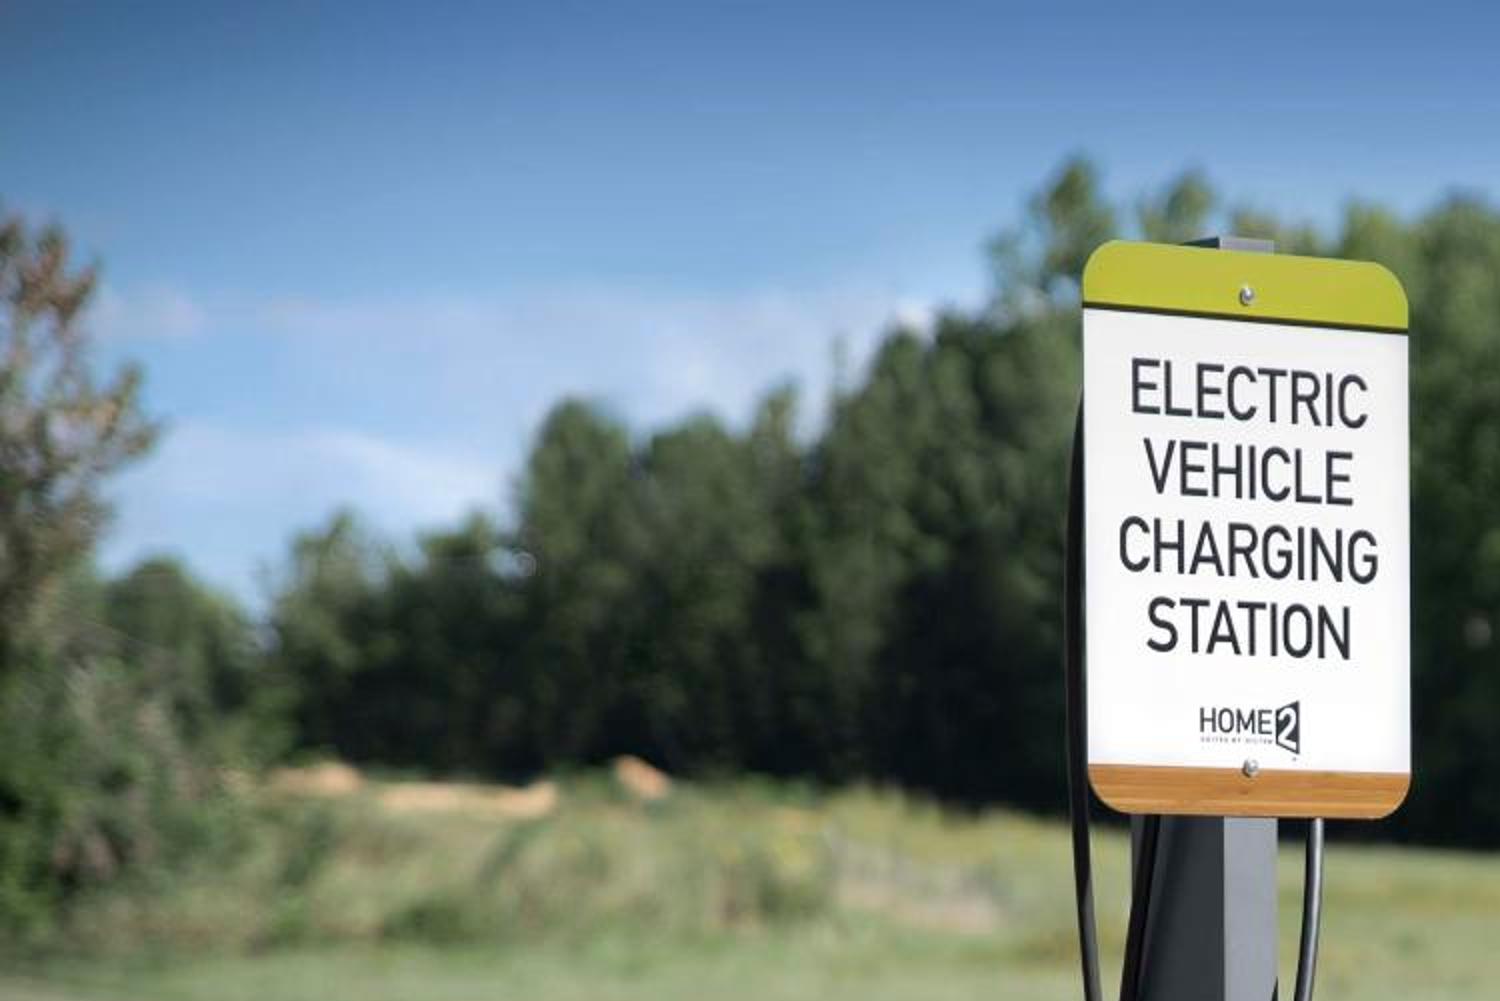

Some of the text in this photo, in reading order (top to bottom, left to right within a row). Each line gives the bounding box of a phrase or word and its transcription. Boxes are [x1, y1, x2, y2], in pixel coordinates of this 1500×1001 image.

[1131, 357, 1368, 429] ELECTRIC
[1143, 437, 1353, 506] VEHICLE
[1119, 515, 1378, 585] CHARGING
[1146, 596, 1350, 661] STATION
